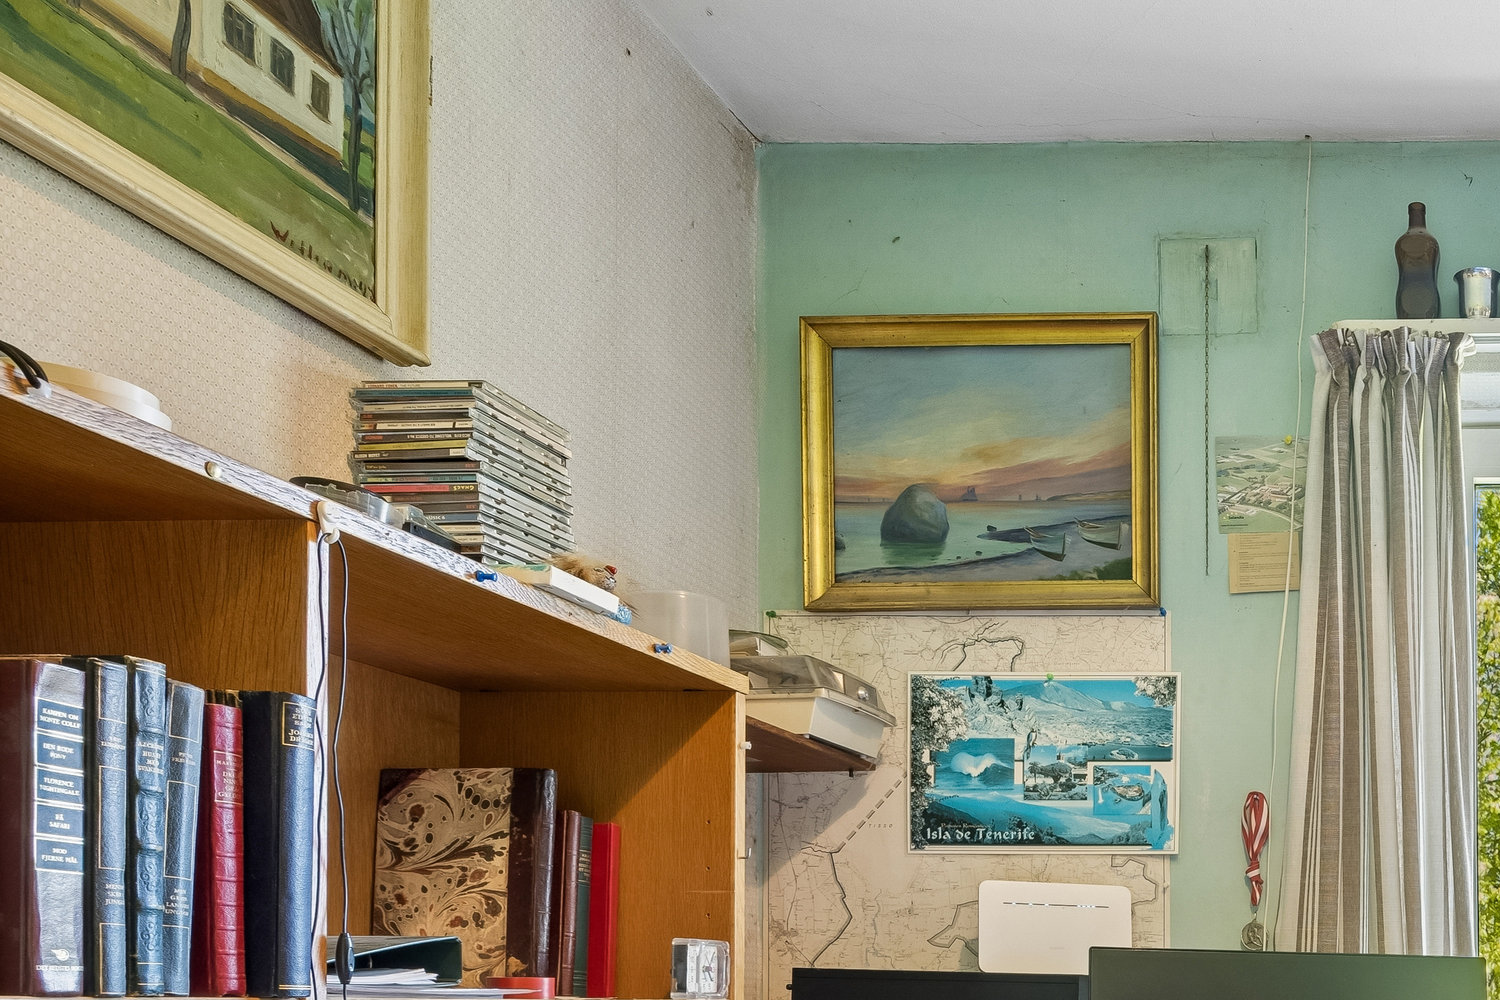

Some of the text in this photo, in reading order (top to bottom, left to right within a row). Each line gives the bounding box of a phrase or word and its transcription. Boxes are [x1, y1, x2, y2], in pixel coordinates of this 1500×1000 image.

[43, 777, 74, 787] FLORENCE
[926, 827, 951, 840] Isla
[955, 829, 971, 840] de
